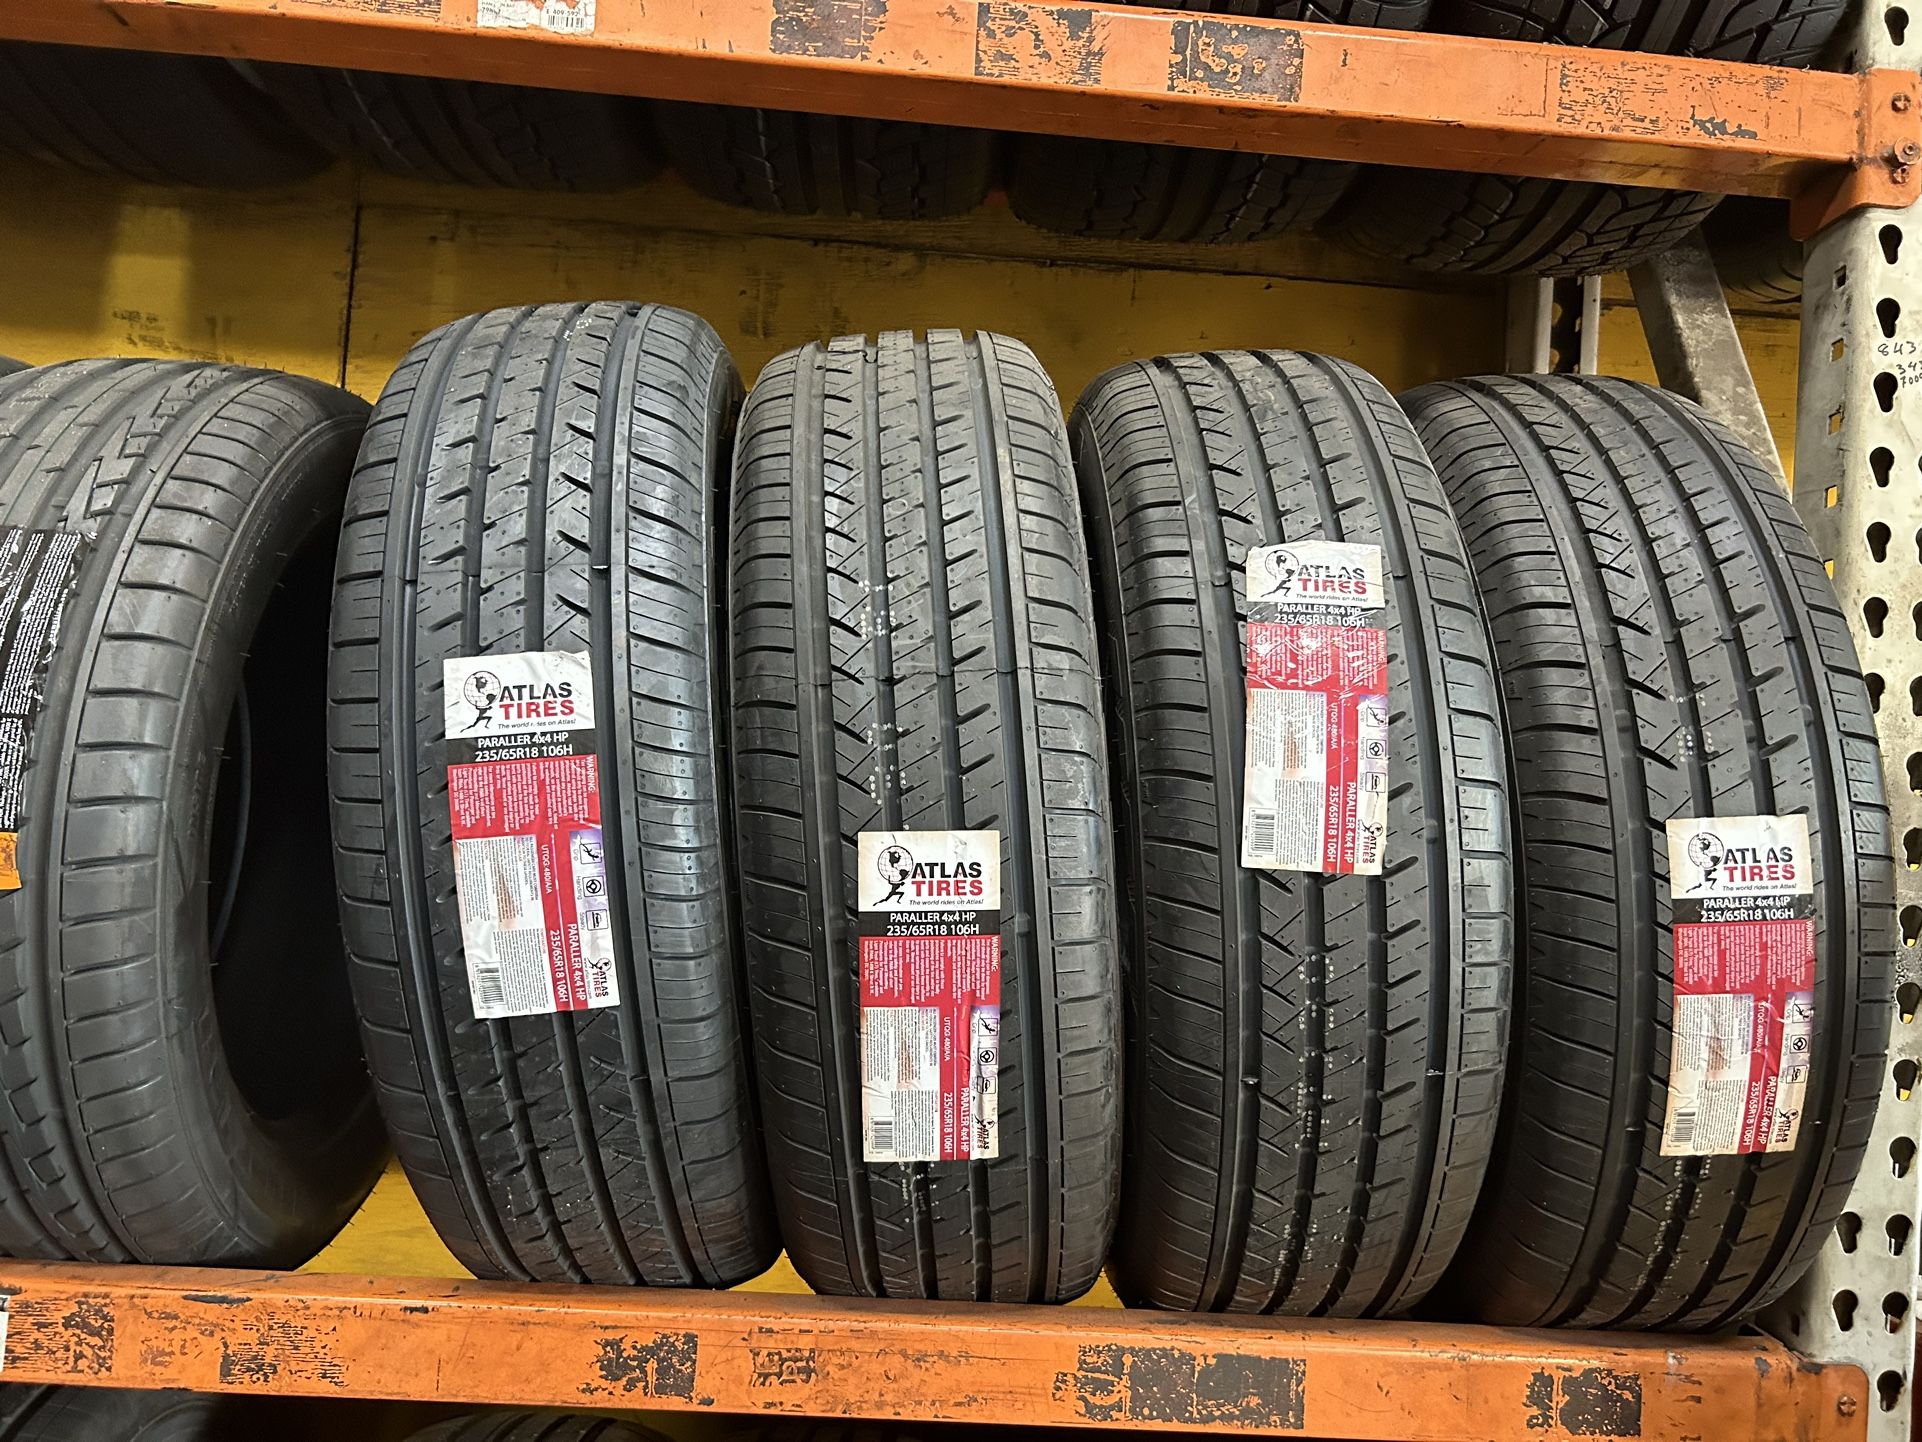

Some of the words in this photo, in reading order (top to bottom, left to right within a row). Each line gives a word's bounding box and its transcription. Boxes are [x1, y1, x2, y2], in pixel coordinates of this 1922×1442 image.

[1298, 564, 1365, 580] ATLAS
[1297, 578, 1367, 595] TIRES
[1277, 603, 1326, 614] PARALLER
[1328, 605, 1346, 614] 4x4
[499, 682, 573, 702] ATLAS
[499, 699, 575, 720] TIRES
[477, 735, 532, 749] PARALLER
[532, 732, 552, 744] 4x4
[553, 732, 569, 743] HP
[475, 748, 540, 762] 235/65R18
[542, 744, 573, 756] 106H
[1328, 785, 1339, 836] 235/65R18
[1345, 782, 1356, 830] PARALLER
[1344, 830, 1355, 847] 4x4
[1326, 837, 1337, 862] 106H
[1344, 849, 1354, 864] HP
[1362, 836, 1370, 864] TIRES
[1368, 836, 1377, 864] ATLAS
[1723, 846, 1793, 864] ATLAS
[911, 862, 982, 879] ATLAS
[1724, 864, 1796, 882] TIRES
[576, 876, 584, 900] Handling
[911, 880, 983, 897] TIRES
[1735, 884, 1752, 892] world
[1703, 898, 1755, 908] PARALLER
[1756, 896, 1774, 907] 4x4
[890, 912, 940, 922] PARALLER
[942, 912, 960, 922] 4x4
[962, 912, 976, 922] HP
[1700, 910, 1762, 922] 235/65R18
[1764, 908, 1794, 921] 106H
[886, 924, 948, 936] 235/65R18
[950, 924, 980, 936] 106H
[550, 930, 563, 978] 235/65R18
[567, 923, 582, 969] PARALLER
[573, 970, 584, 987] 4x4
[592, 970, 602, 998] TIRES
[598, 970, 610, 998] ATLAS
[554, 980, 568, 1002] 106H
[576, 987, 586, 1000] HP
[960, 1087, 969, 1126] PARALLER
[1746, 1081, 1760, 1124] 235/65R18
[944, 1092, 952, 1132] 235/65R18
[1759, 1116, 1772, 1132] 4x4
[1775, 1120, 1784, 1144] TIRES
[1781, 1120, 1791, 1142] ATLAS
[960, 1126, 969, 1141] 4x4
[1743, 1125, 1754, 1146] 106H
[1757, 1132, 1768, 1144] HP
[944, 1134, 952, 1152] 106H
[960, 1142, 969, 1152] HP
